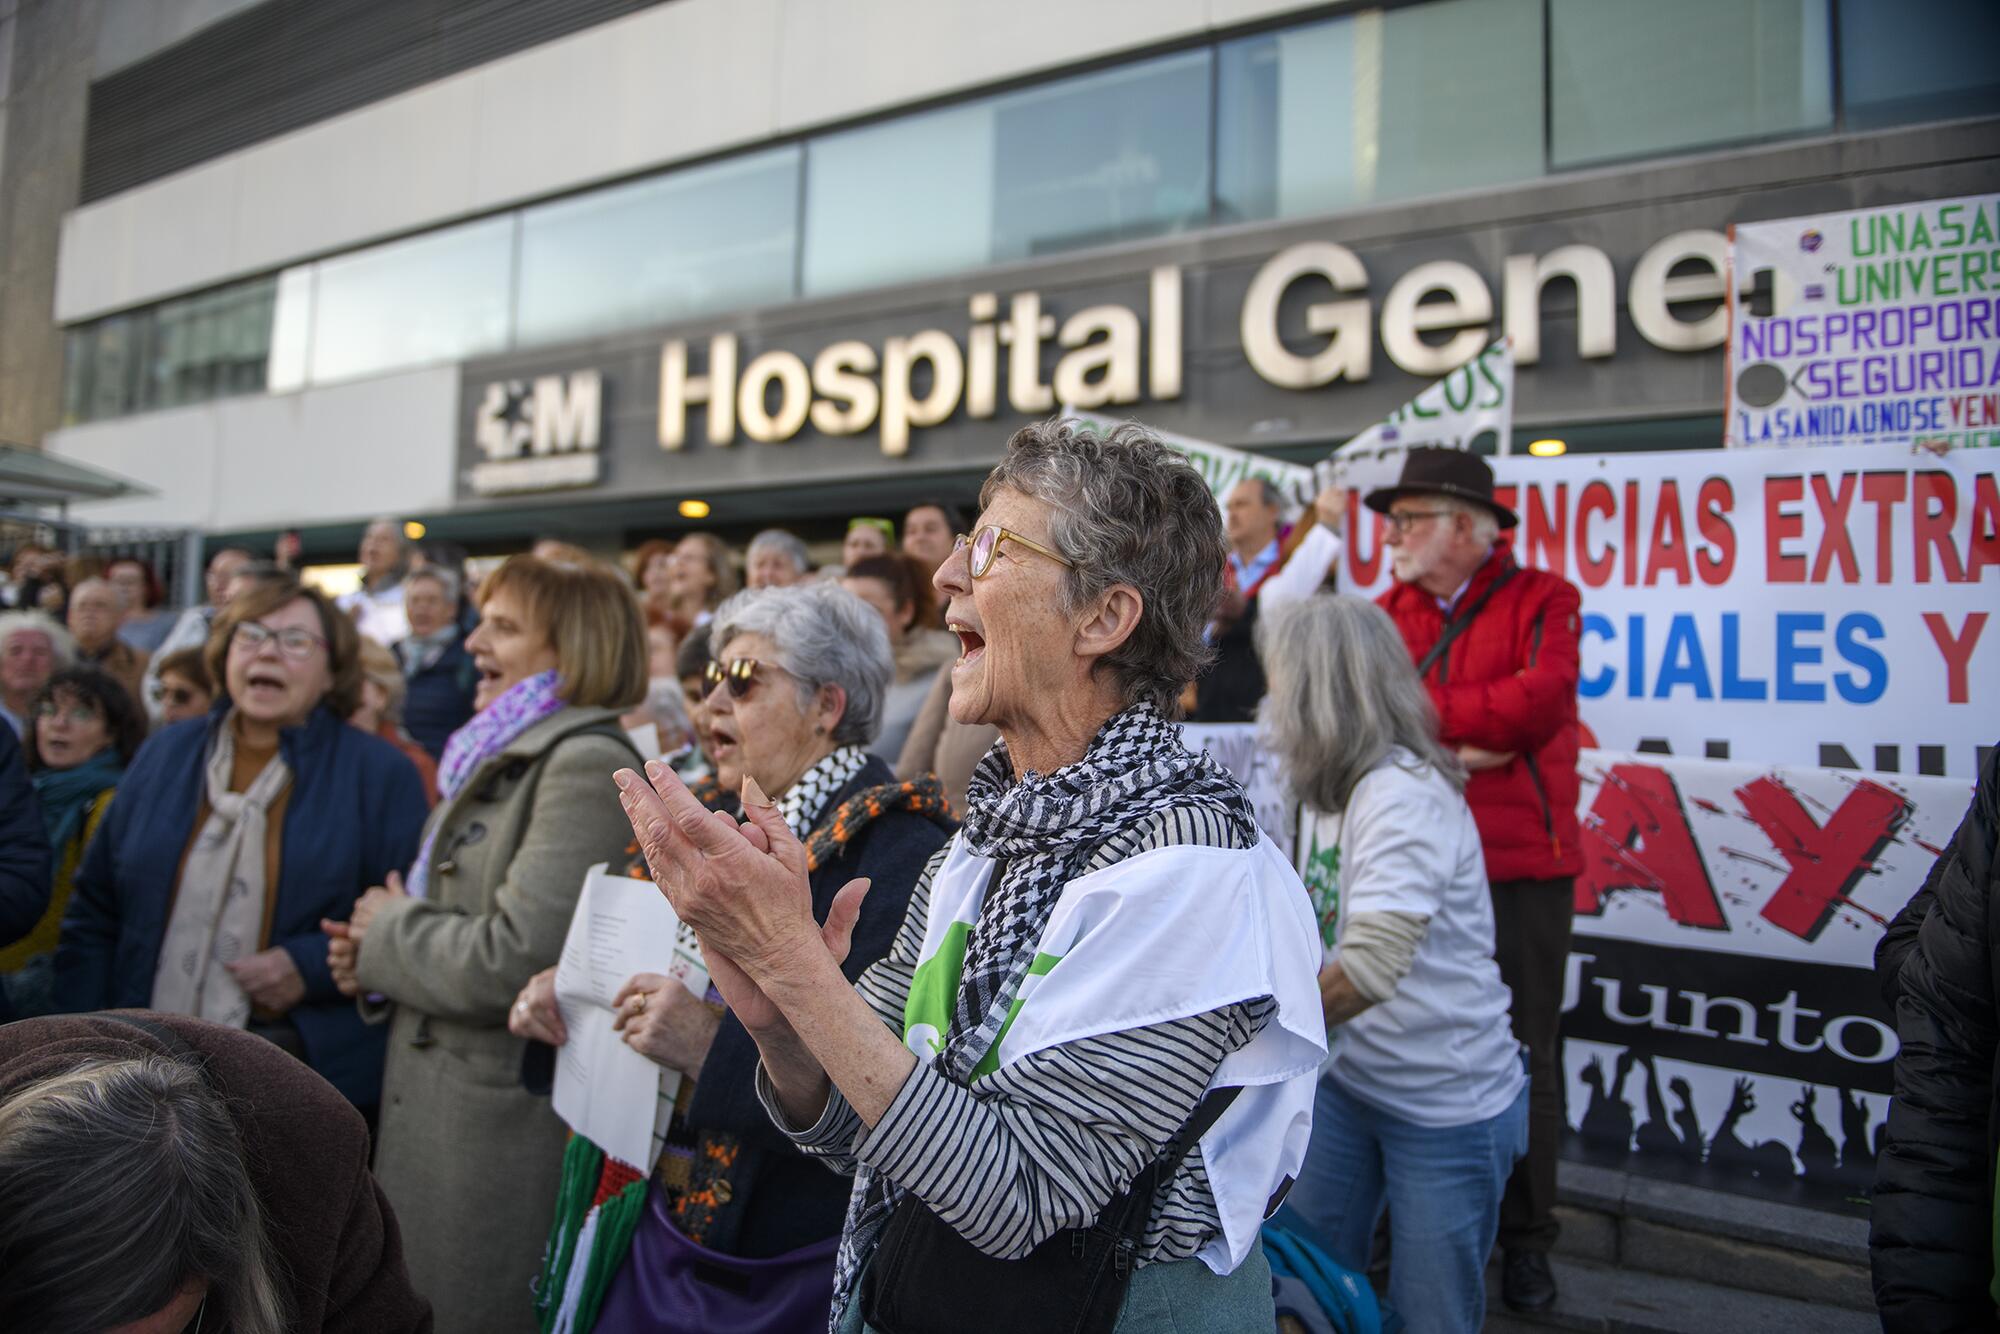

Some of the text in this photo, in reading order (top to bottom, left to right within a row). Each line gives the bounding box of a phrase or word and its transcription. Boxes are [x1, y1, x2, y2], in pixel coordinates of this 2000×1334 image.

[1851, 200, 2000, 258] UNA SA
[657, 264, 1183, 456] Hospital
[1824, 296, 2000, 353] PROPOR
[1346, 474, 1736, 588] UNCIAS
[1921, 611, 1990, 704] Y
